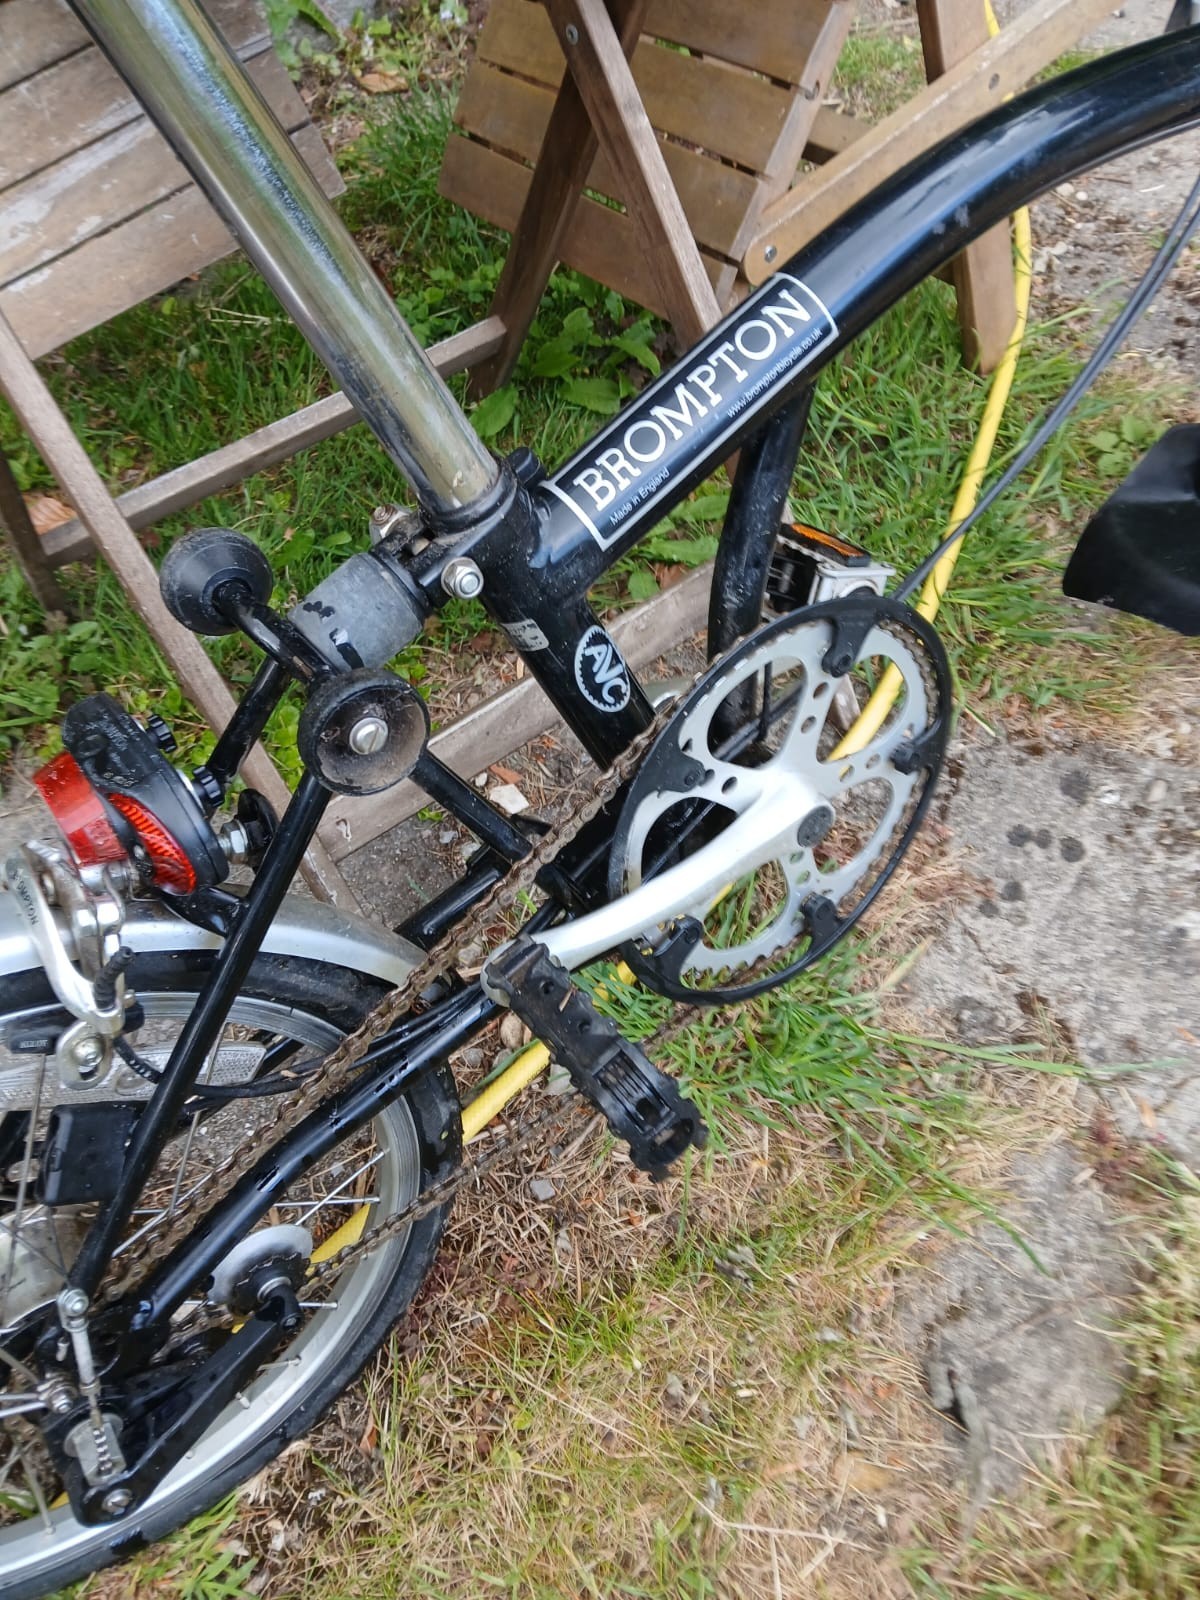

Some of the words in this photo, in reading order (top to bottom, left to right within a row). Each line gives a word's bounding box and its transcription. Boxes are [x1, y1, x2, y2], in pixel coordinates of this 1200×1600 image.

[573, 288, 812, 511] BROMPTON
[609, 503, 633, 526] Made
[631, 495, 641, 506] in
[638, 466, 670, 499] England
[584, 643, 627, 704] AVC
